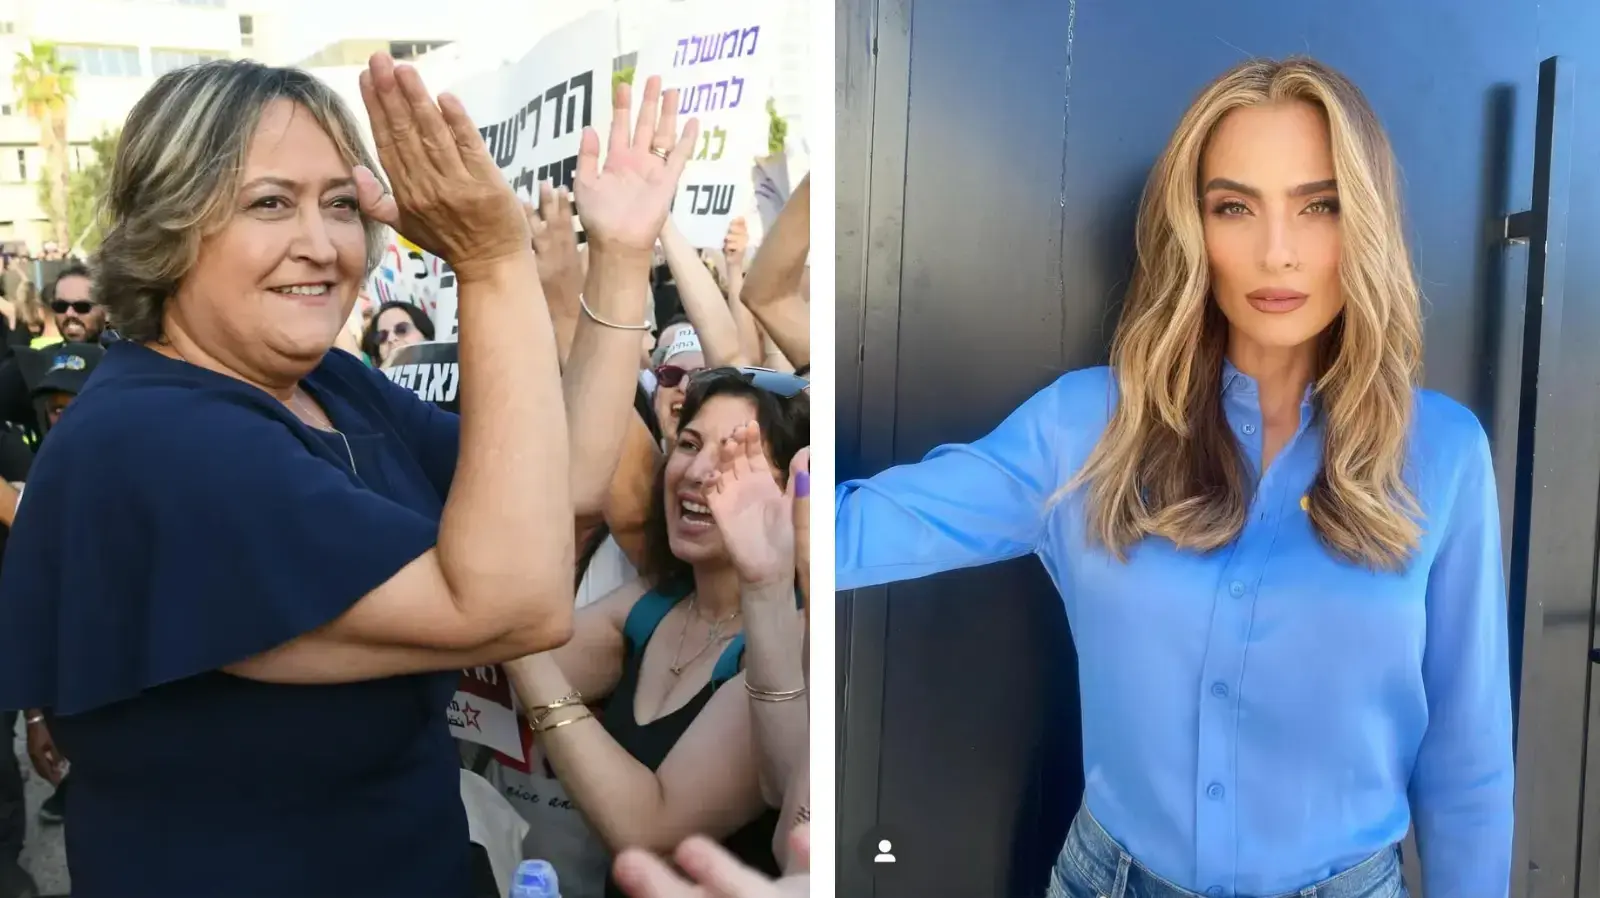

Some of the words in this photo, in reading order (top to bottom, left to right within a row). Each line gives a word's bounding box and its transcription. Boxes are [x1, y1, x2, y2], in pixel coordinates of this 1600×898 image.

[673, 25, 760, 68] ממשלה
[661, 76, 744, 114] להתע
[696, 125, 727, 160] לג
[686, 184, 735, 216] שכר
